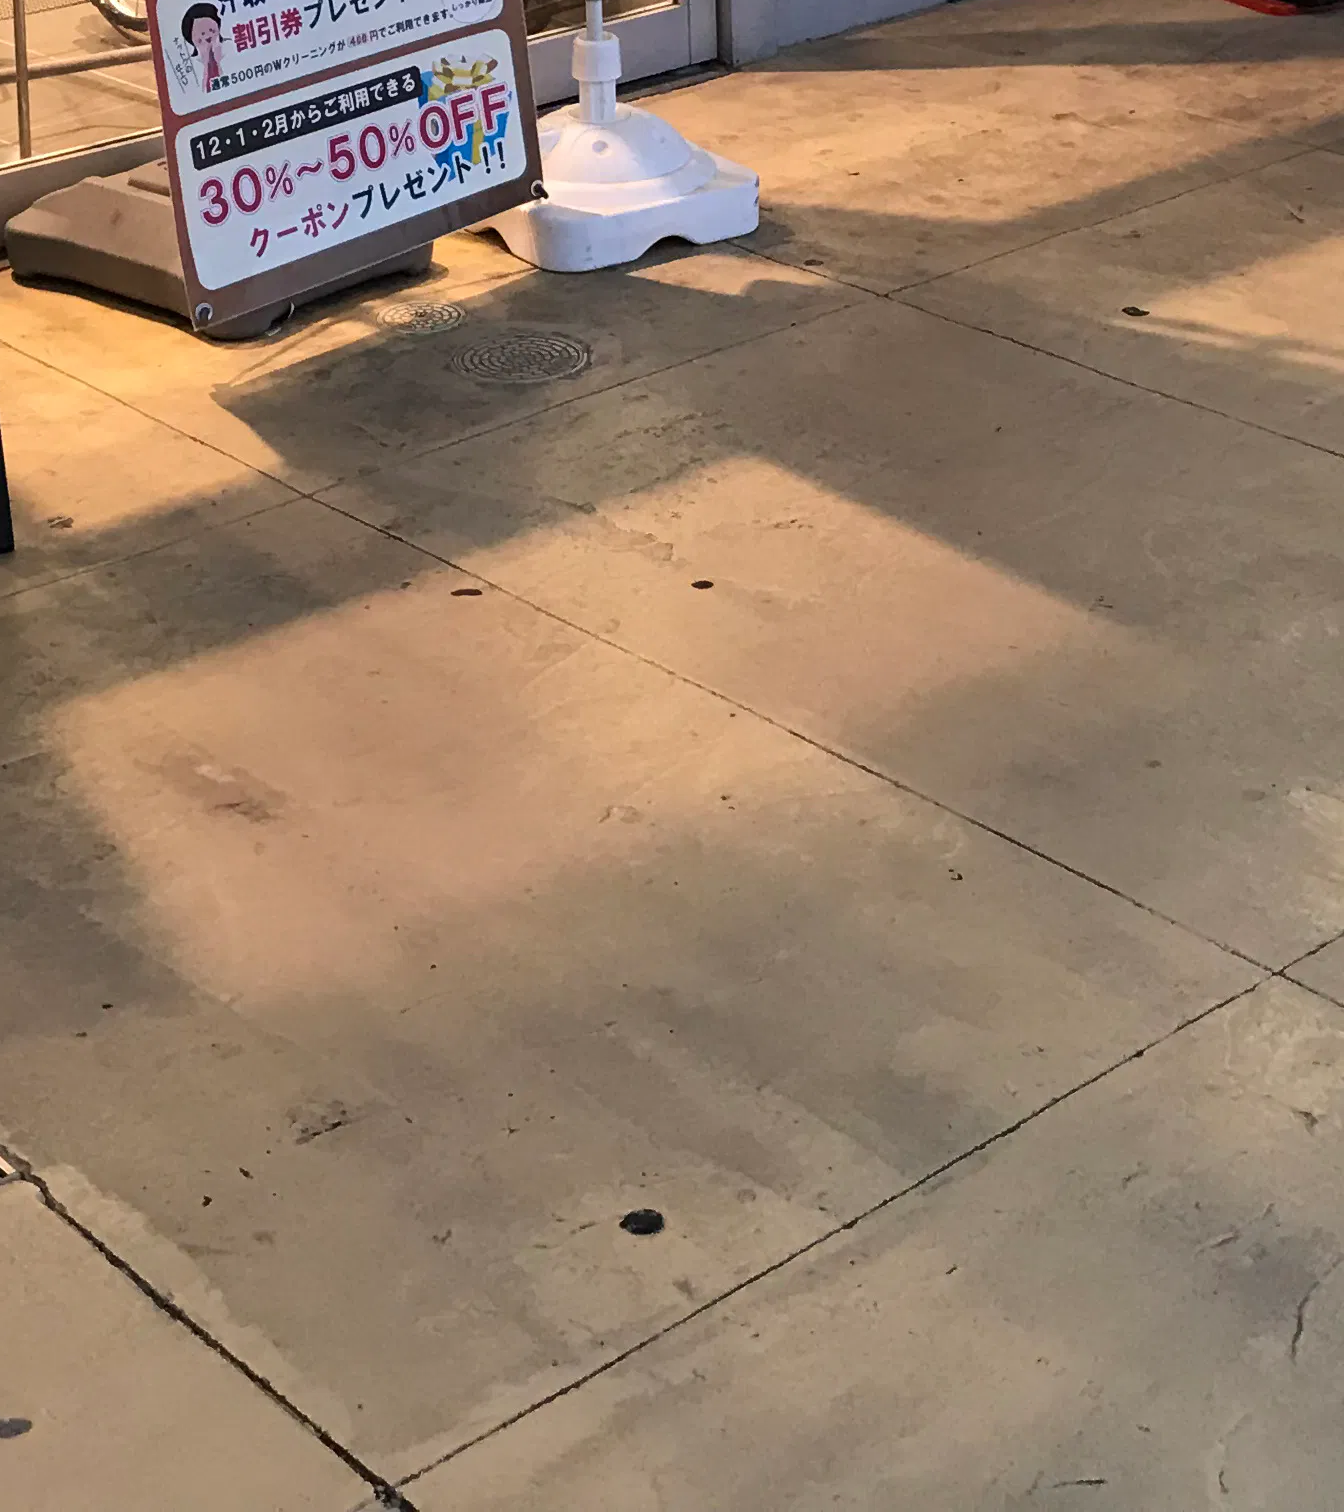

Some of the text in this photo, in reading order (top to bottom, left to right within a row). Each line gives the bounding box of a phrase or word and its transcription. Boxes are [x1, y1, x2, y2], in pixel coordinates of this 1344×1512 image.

[249, 140, 508, 259] クーポンプレゼント!!
